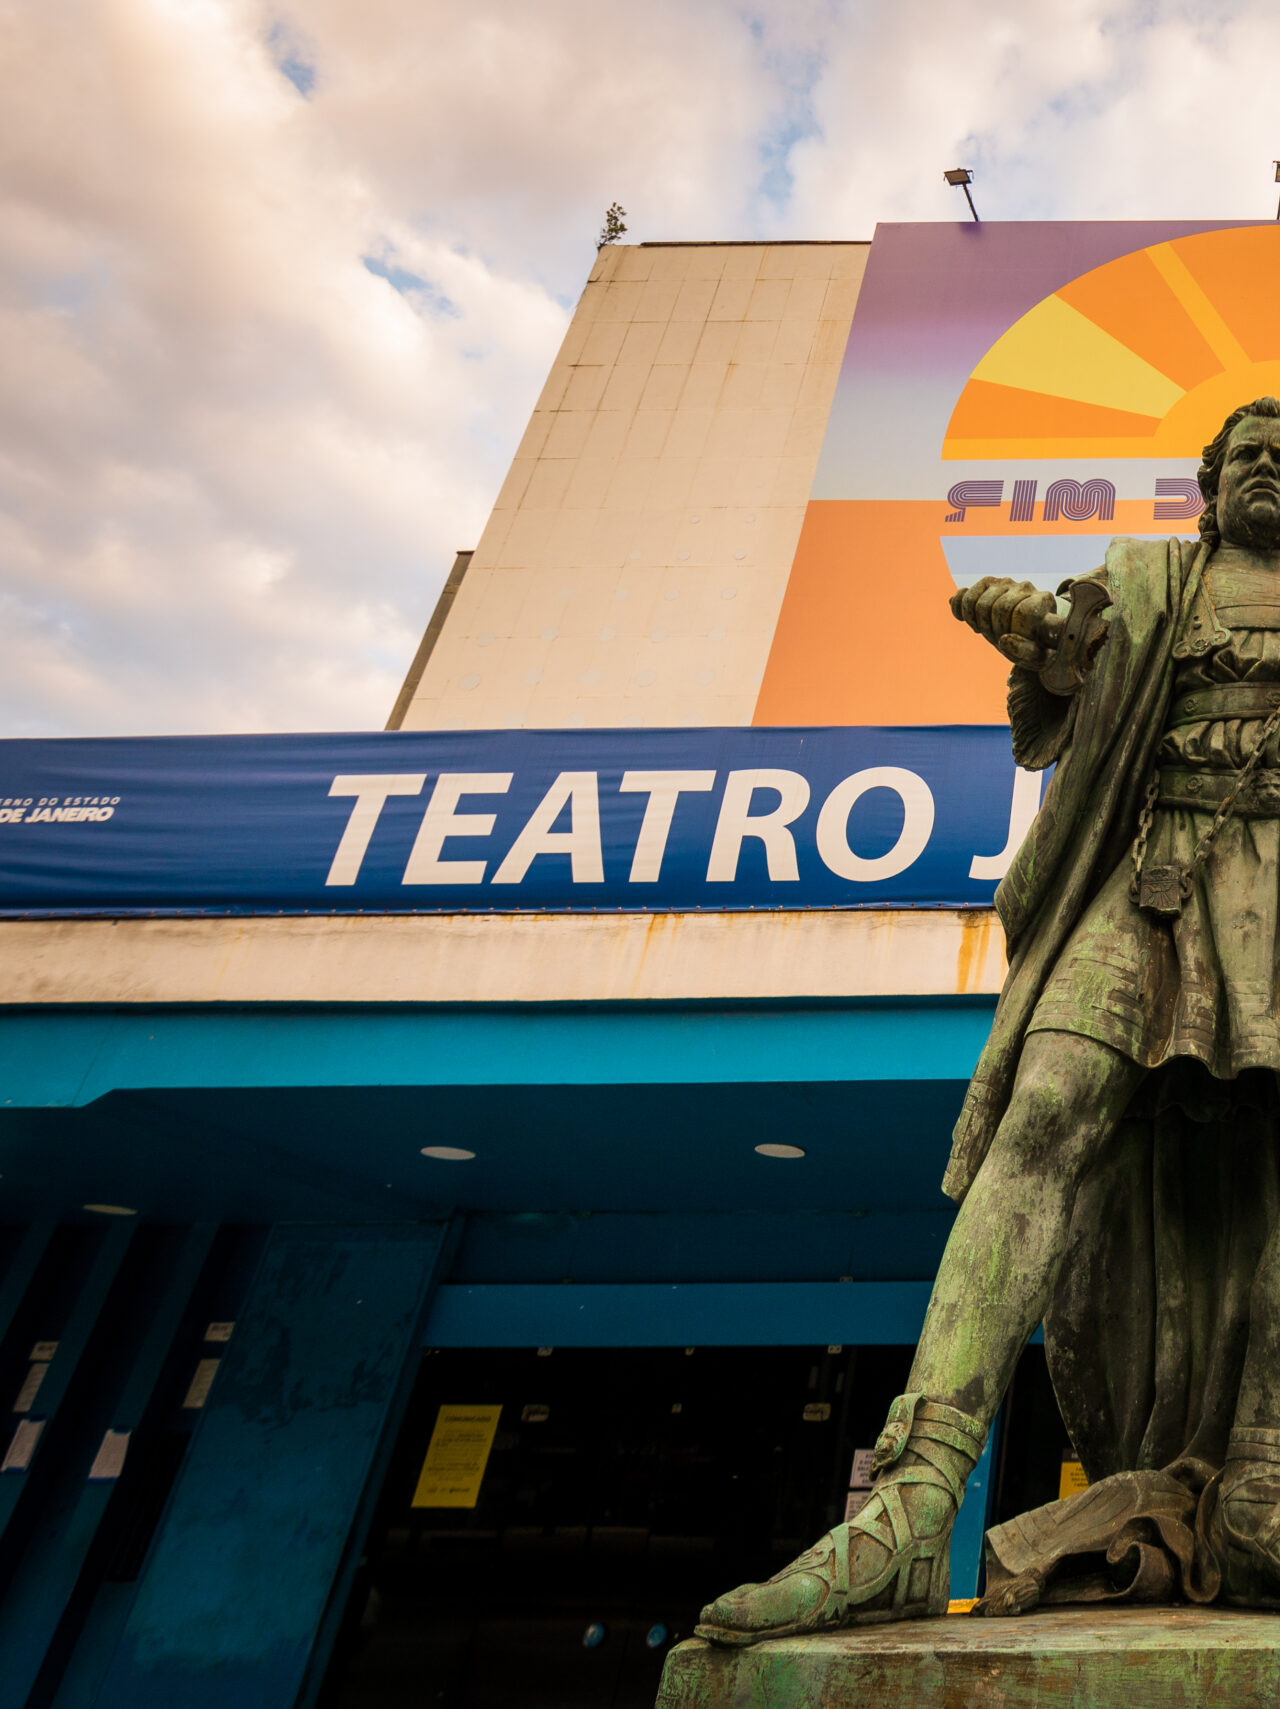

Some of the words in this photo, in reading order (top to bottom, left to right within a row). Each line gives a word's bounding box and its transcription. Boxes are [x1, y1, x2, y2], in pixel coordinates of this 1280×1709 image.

[944, 478, 1116, 522] FIM
[1153, 478, 1206, 520] D
[0, 798, 33, 807] RNO
[38, 797, 58, 806] DO
[63, 796, 121, 806] ESTADO
[24, 807, 115, 823] JANEIRO
[324, 766, 936, 887] TEATRO
